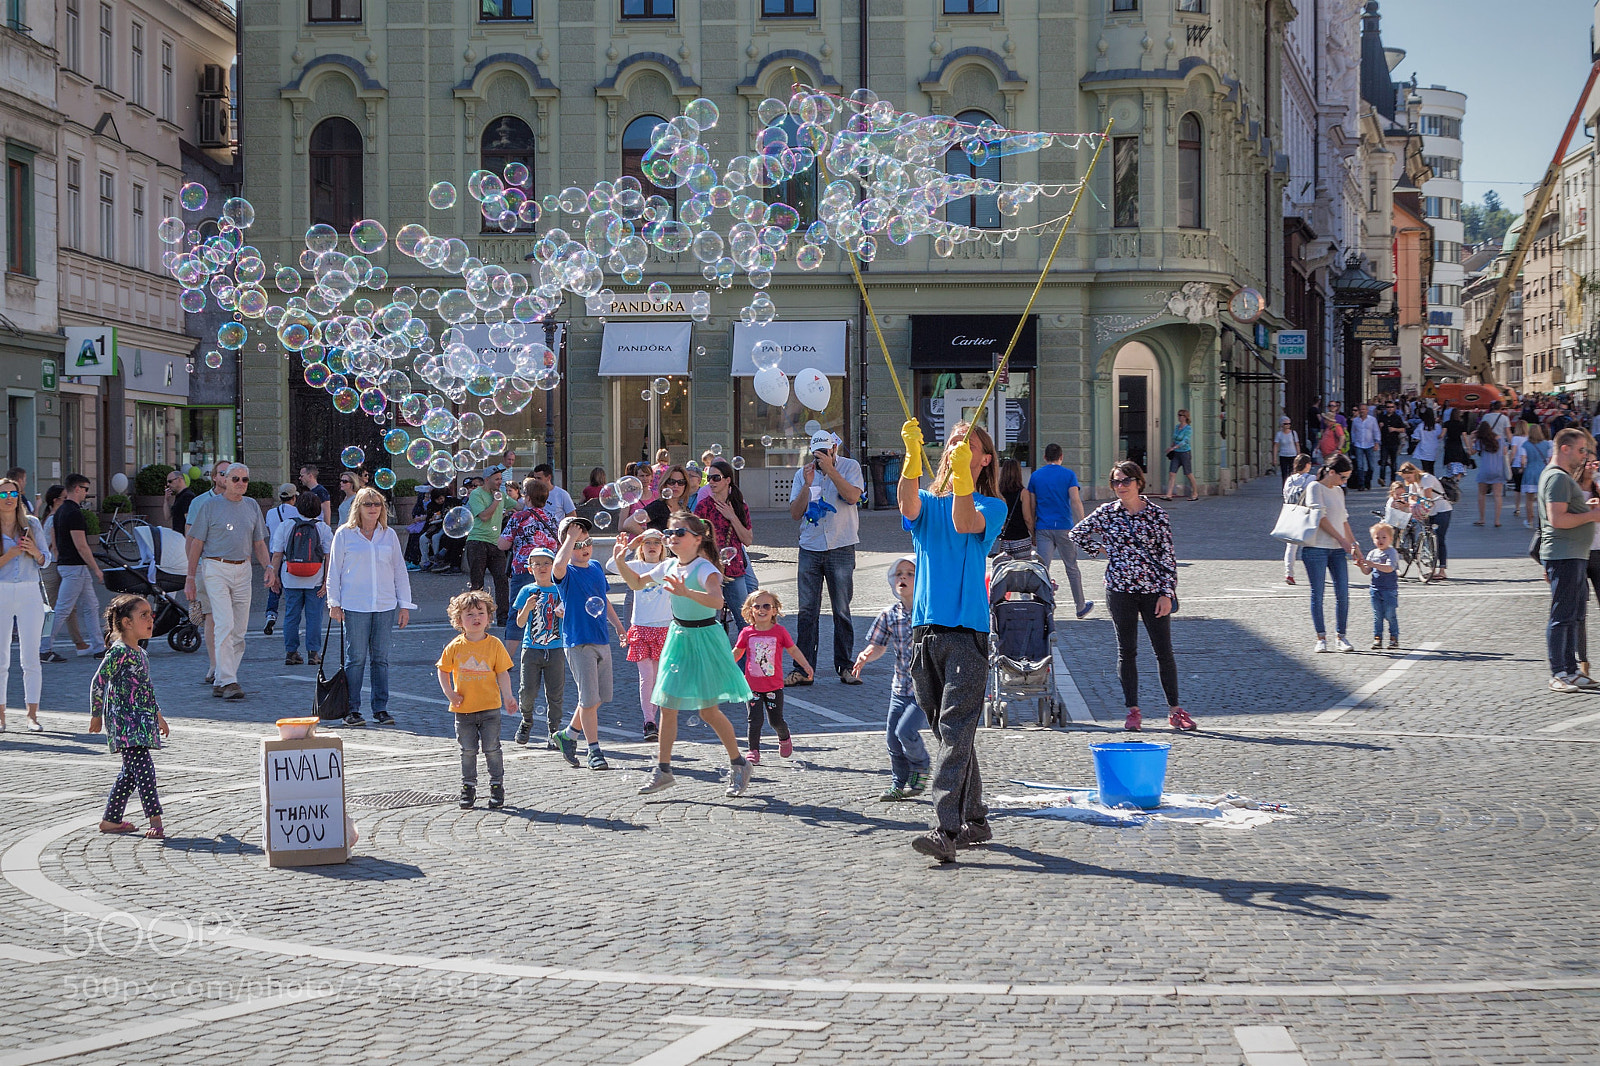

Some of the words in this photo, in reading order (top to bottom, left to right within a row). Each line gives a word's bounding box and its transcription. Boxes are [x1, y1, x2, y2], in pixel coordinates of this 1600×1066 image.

[610, 301, 685, 313] PANDORA
[951, 335, 997, 346] Cartier
[1280, 336, 1304, 344] back
[75, 335, 105, 366] A1
[617, 344, 673, 352] PANDORA
[761, 344, 817, 352] PANDORA
[1278, 346, 1305, 355] WERK
[274, 752, 341, 782] HVALA
[275, 804, 330, 821] THANK
[280, 823, 325, 844] YOU
